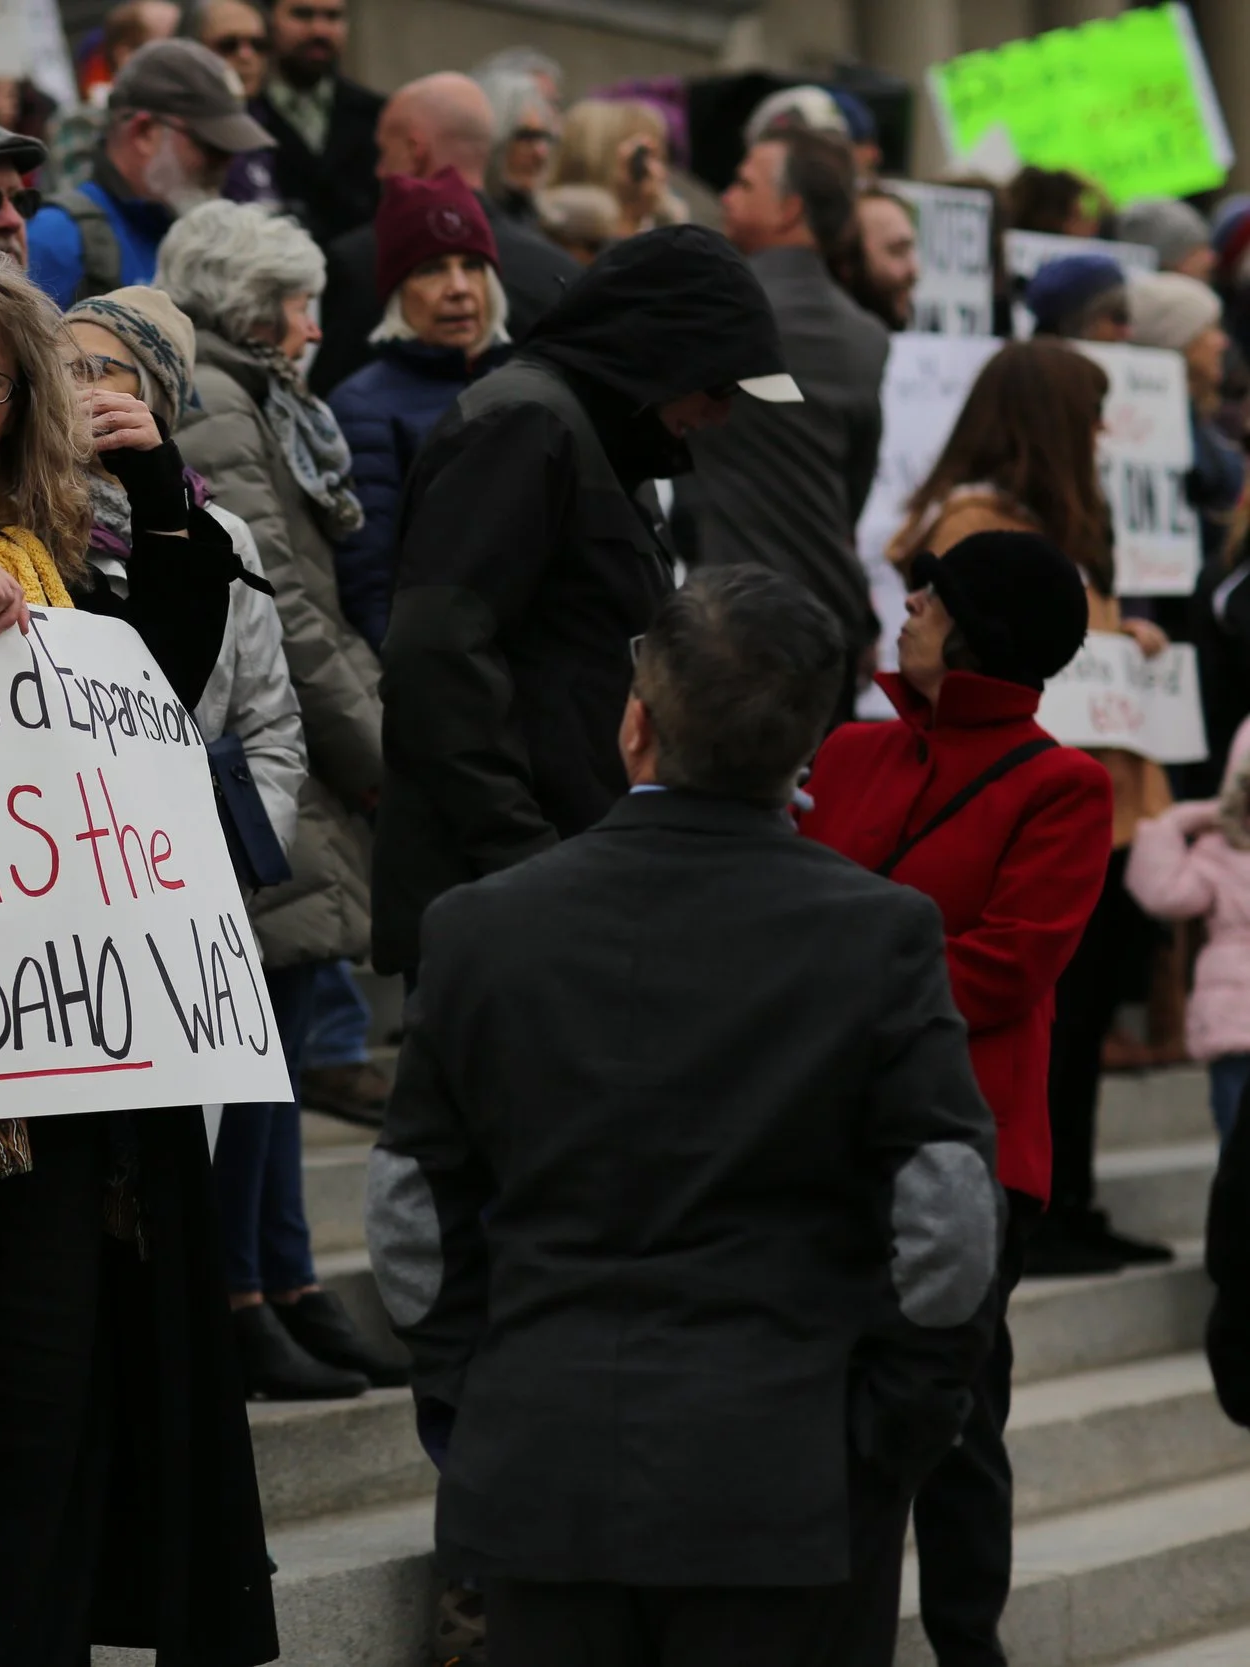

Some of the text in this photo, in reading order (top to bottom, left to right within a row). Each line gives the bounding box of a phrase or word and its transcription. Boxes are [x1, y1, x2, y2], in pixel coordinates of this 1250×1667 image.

[28, 610, 204, 757] Expansion
[76, 767, 186, 906] the
[146, 912, 268, 1056] WAY
